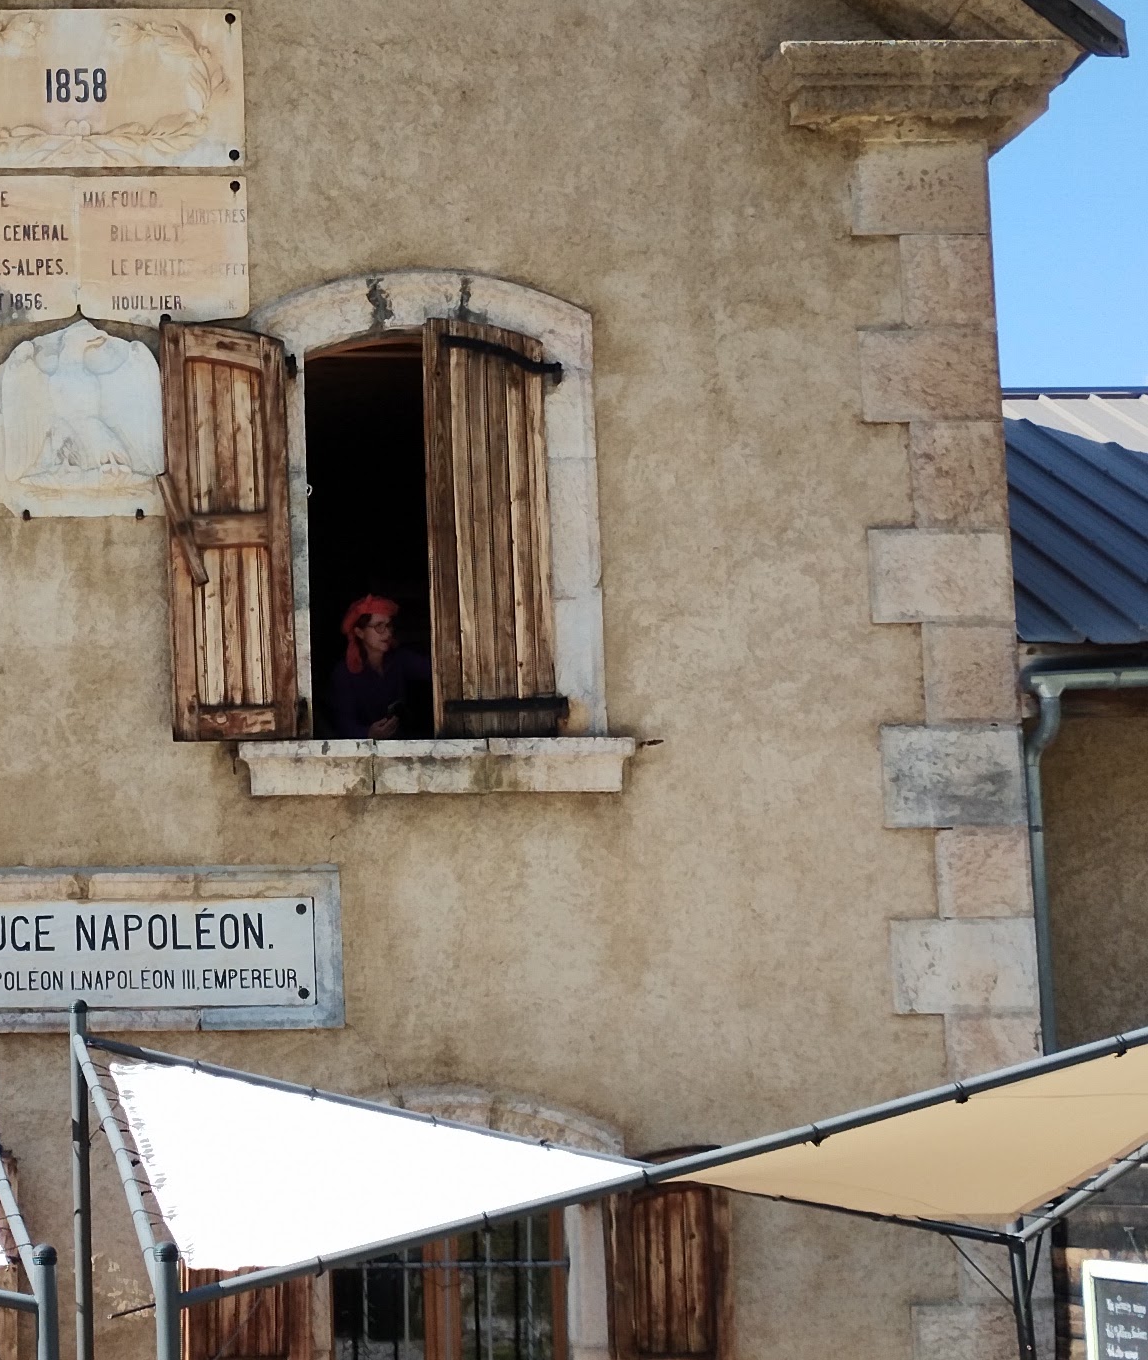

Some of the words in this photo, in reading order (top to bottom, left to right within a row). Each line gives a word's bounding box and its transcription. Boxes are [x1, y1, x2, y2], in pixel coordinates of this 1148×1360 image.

[46, 68, 107, 103] 1858
[111, 259, 129, 276] LE
[75, 908, 274, 951] NAPOLÉON.
